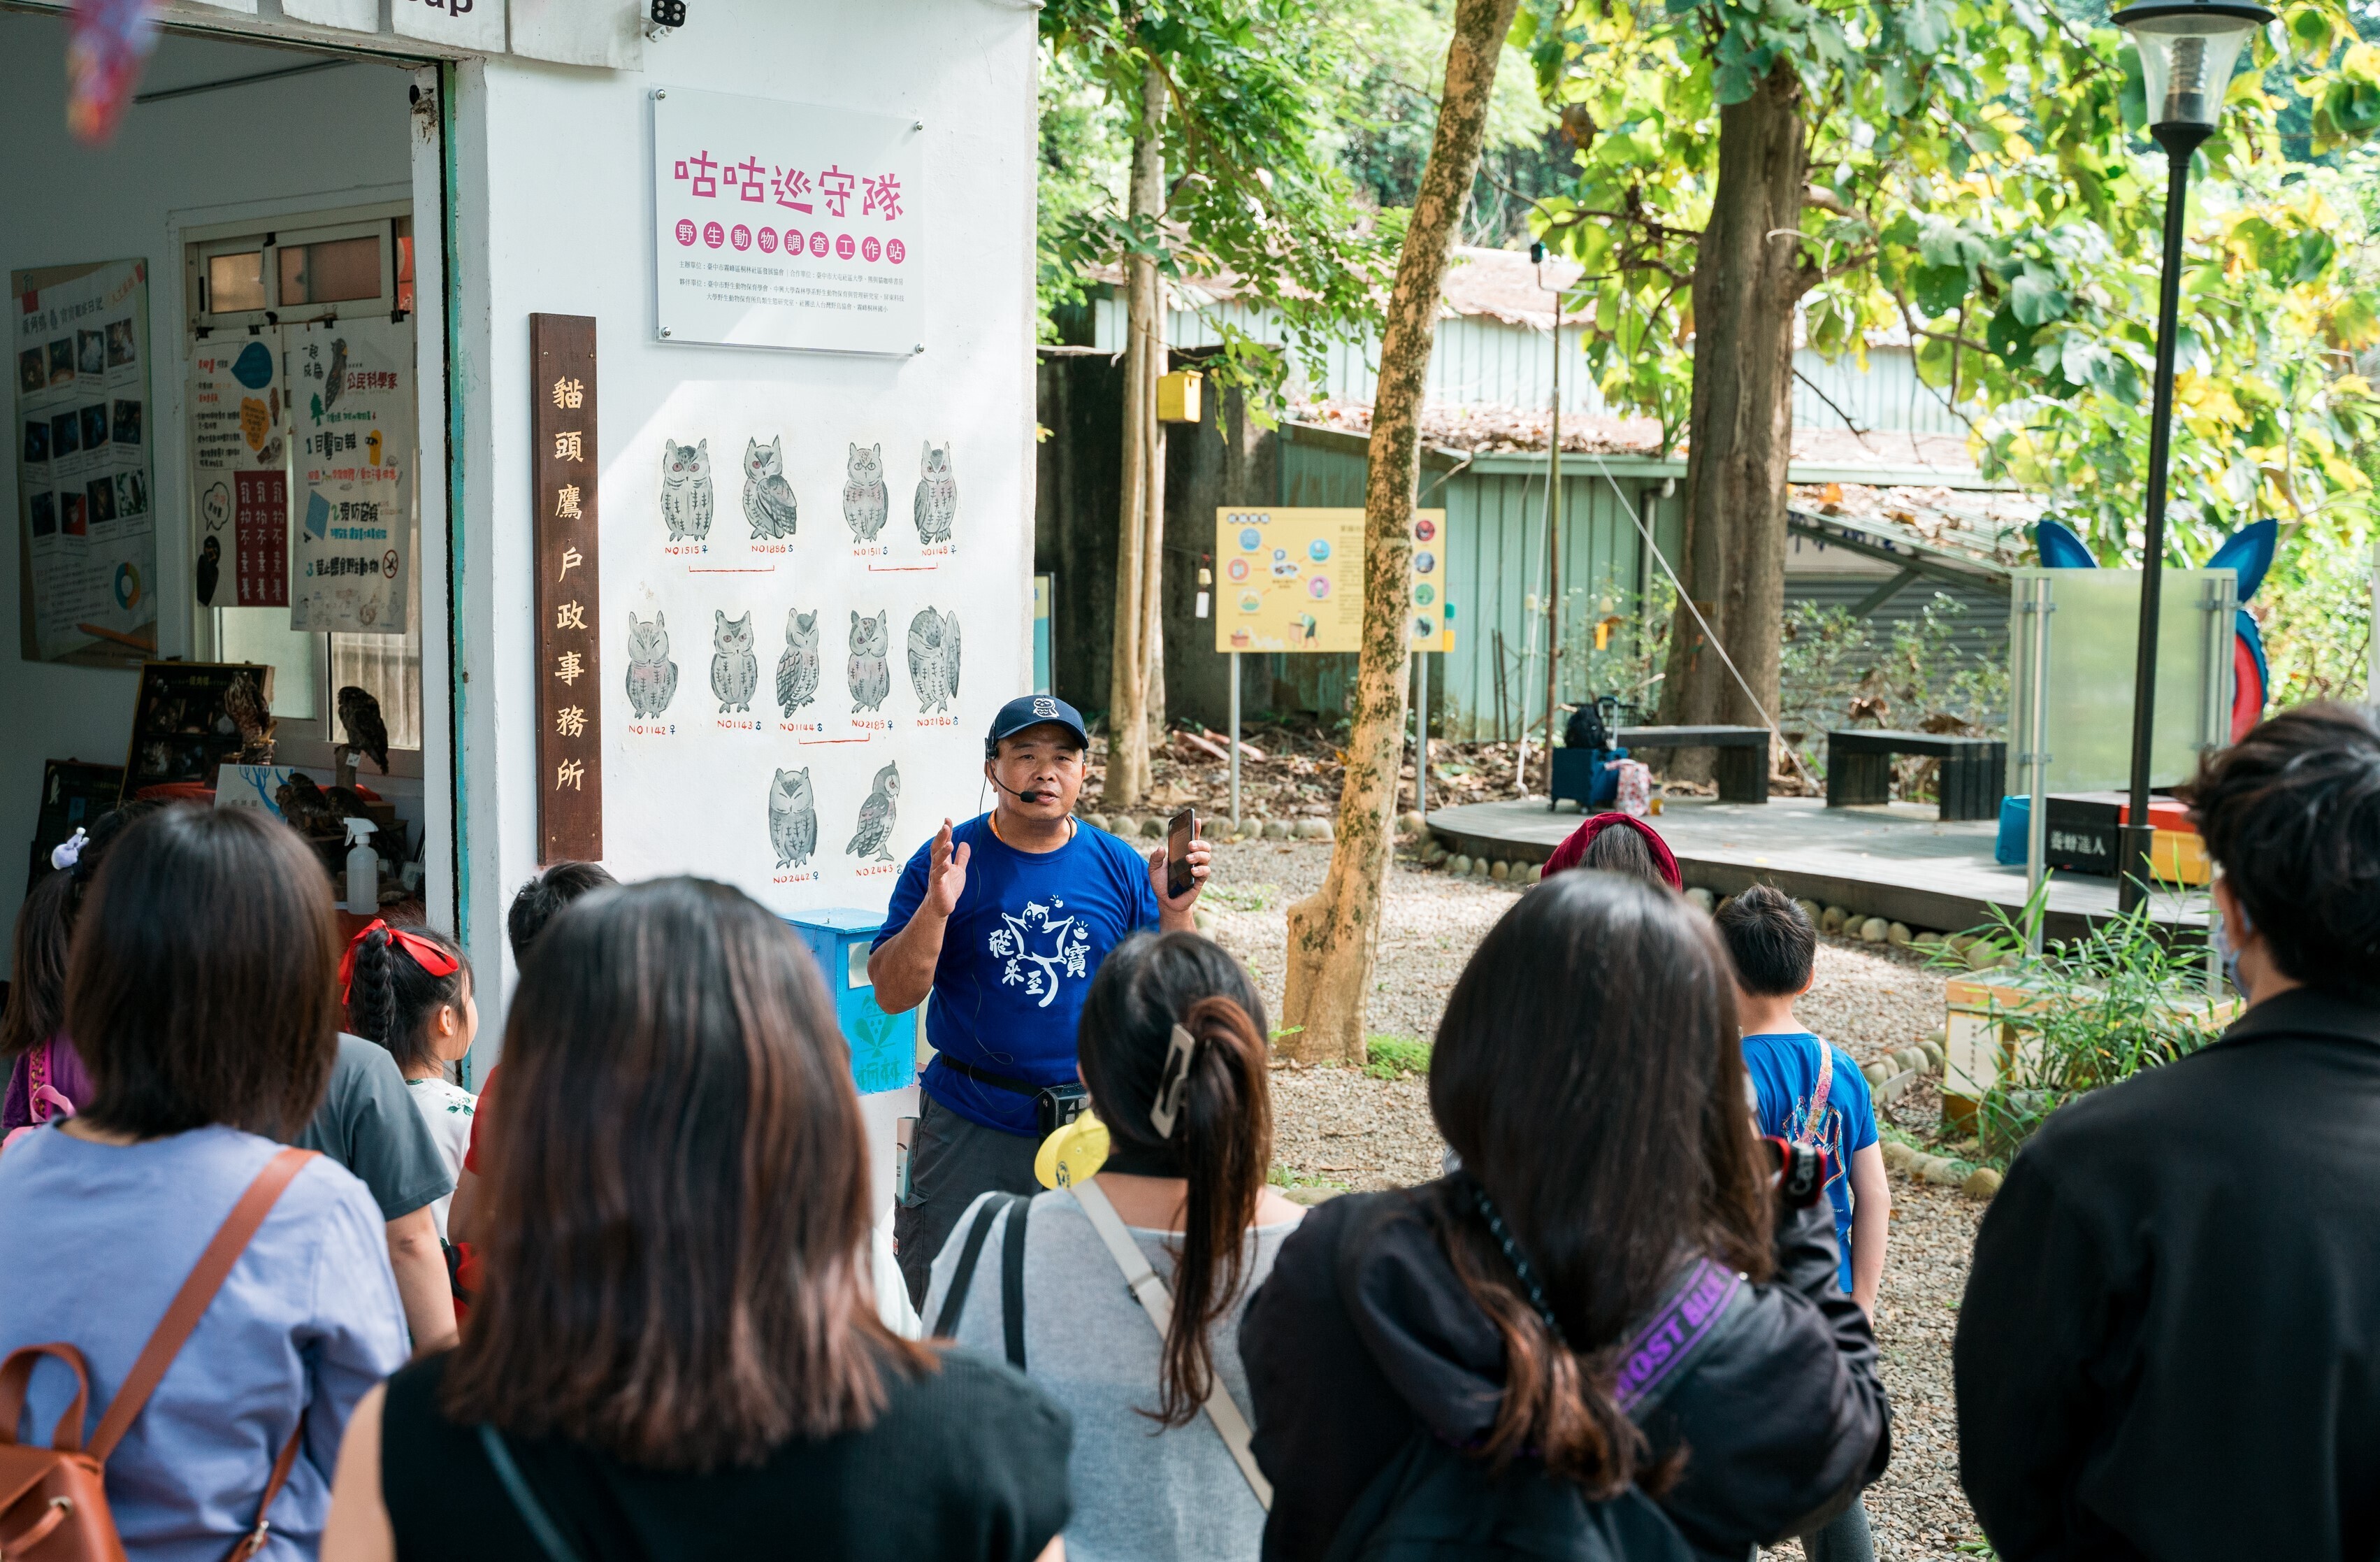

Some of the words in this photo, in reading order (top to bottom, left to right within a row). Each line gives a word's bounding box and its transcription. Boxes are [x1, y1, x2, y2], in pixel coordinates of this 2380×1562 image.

[674, 150, 904, 221] 咕咕巡守隊
[676, 221, 905, 263] 野生動物調查工作站
[302, 343, 319, 359] 一起
[347, 371, 398, 390] 公民科學家
[315, 431, 356, 460] 目擊回報
[552, 375, 589, 792] 貓頭鷹戶政事務所
[988, 929, 1090, 995] 飛來至寶
